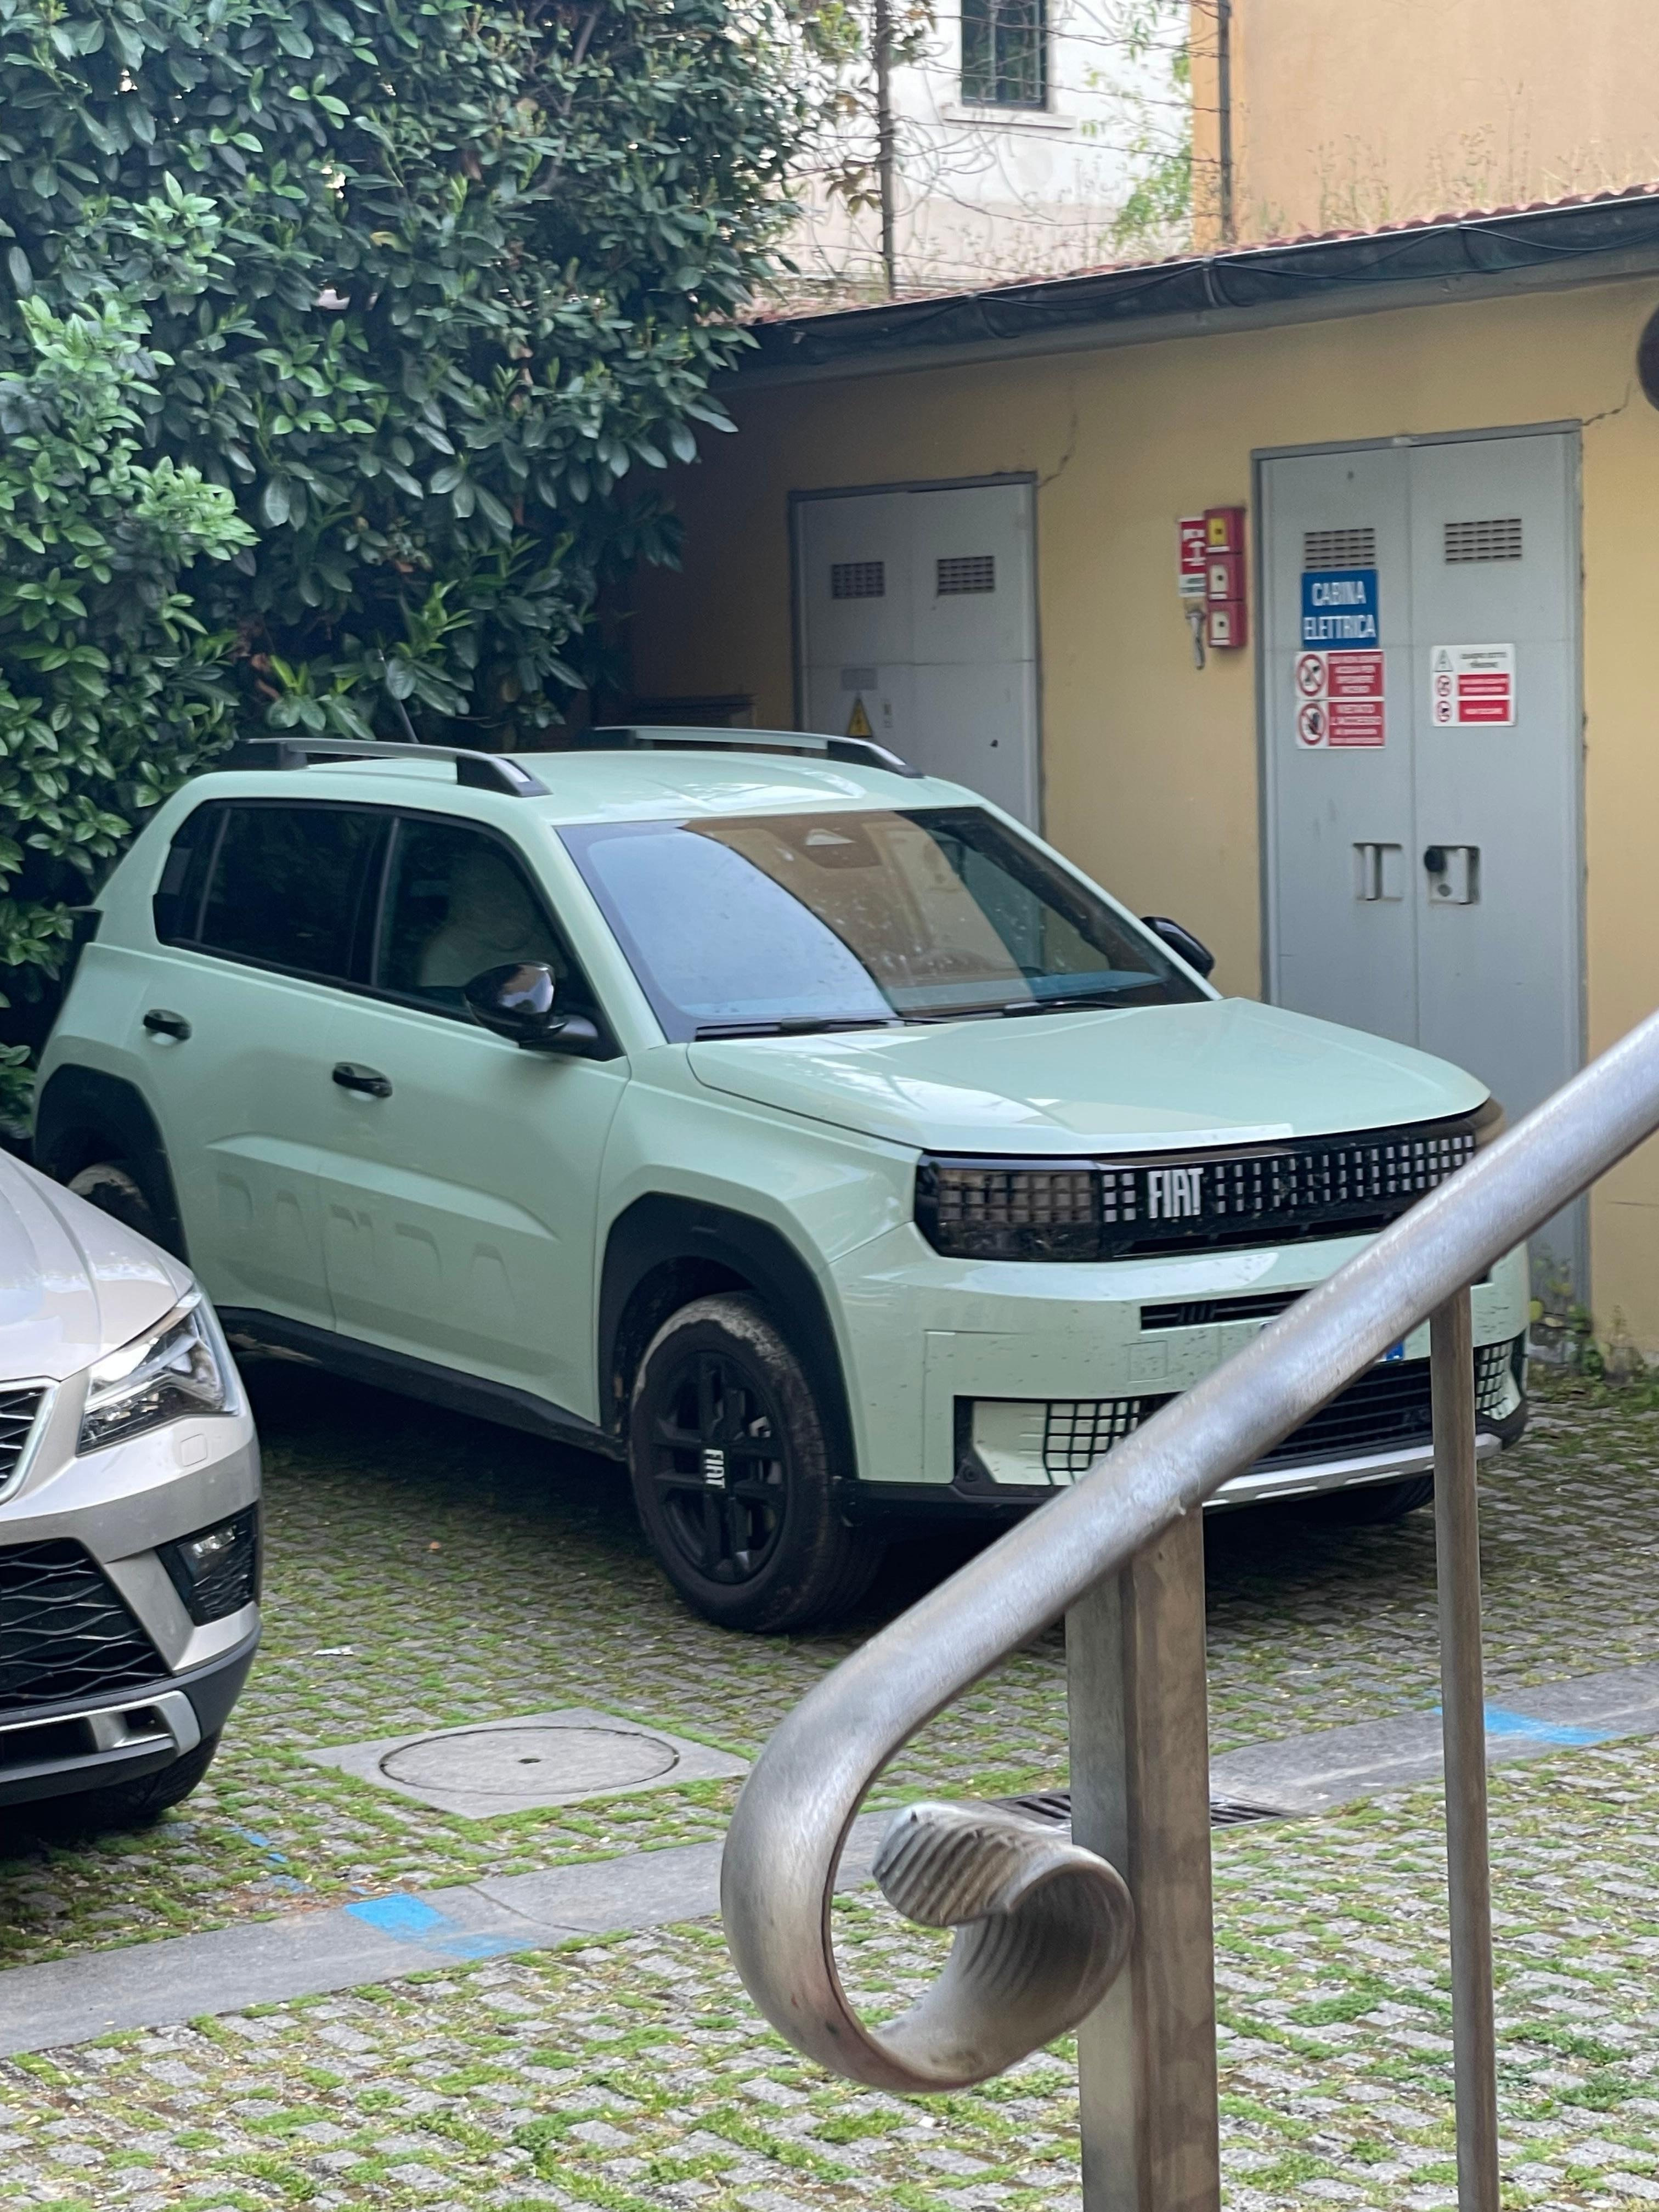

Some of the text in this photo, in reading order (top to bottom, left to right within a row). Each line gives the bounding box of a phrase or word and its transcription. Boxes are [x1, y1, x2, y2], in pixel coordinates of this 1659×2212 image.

[1312, 581, 1367, 606] CABINA
[1304, 614, 1376, 640] ELETTRICA
[1147, 1167, 1204, 1218] FIAT
[704, 1449, 725, 1488] FIAT
